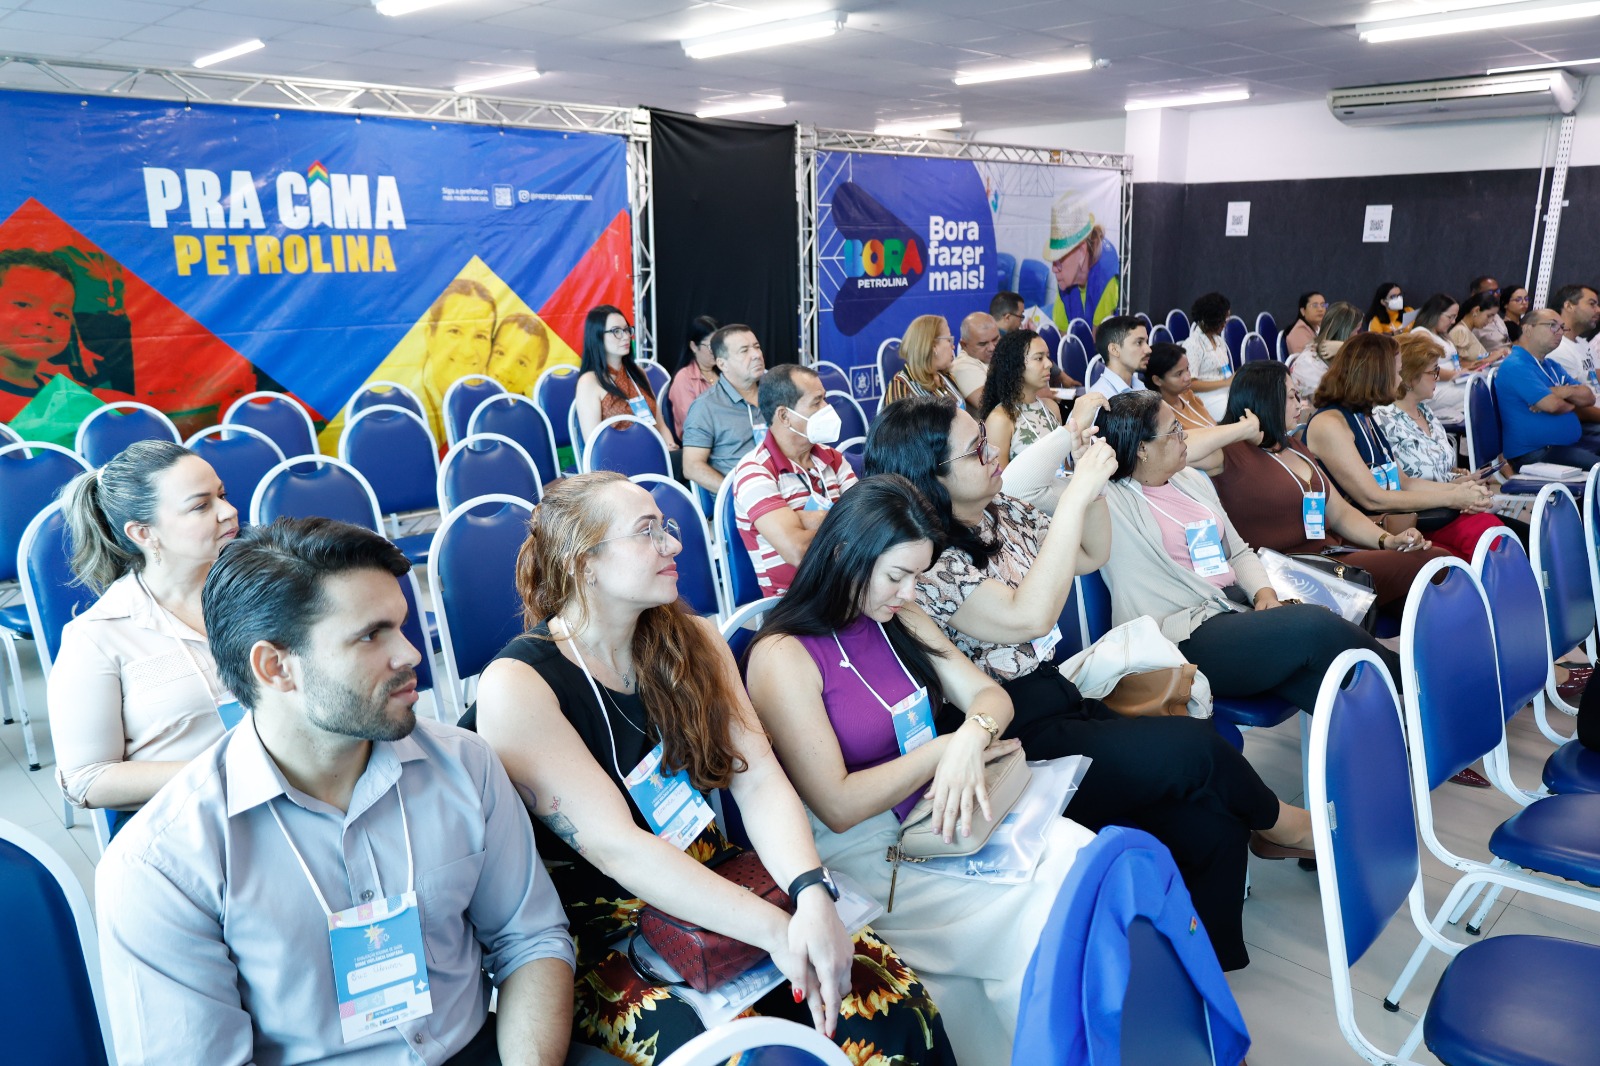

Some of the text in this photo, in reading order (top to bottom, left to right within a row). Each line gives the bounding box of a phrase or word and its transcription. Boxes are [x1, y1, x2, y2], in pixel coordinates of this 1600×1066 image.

[143, 162, 406, 229] PRA CIMA
[929, 215, 979, 241] Bora
[173, 234, 397, 276] PETROLINA
[844, 239, 922, 277] BORA
[928, 240, 984, 267] fazer
[857, 277, 909, 289] PETROLINA
[928, 264, 985, 292] mais!
